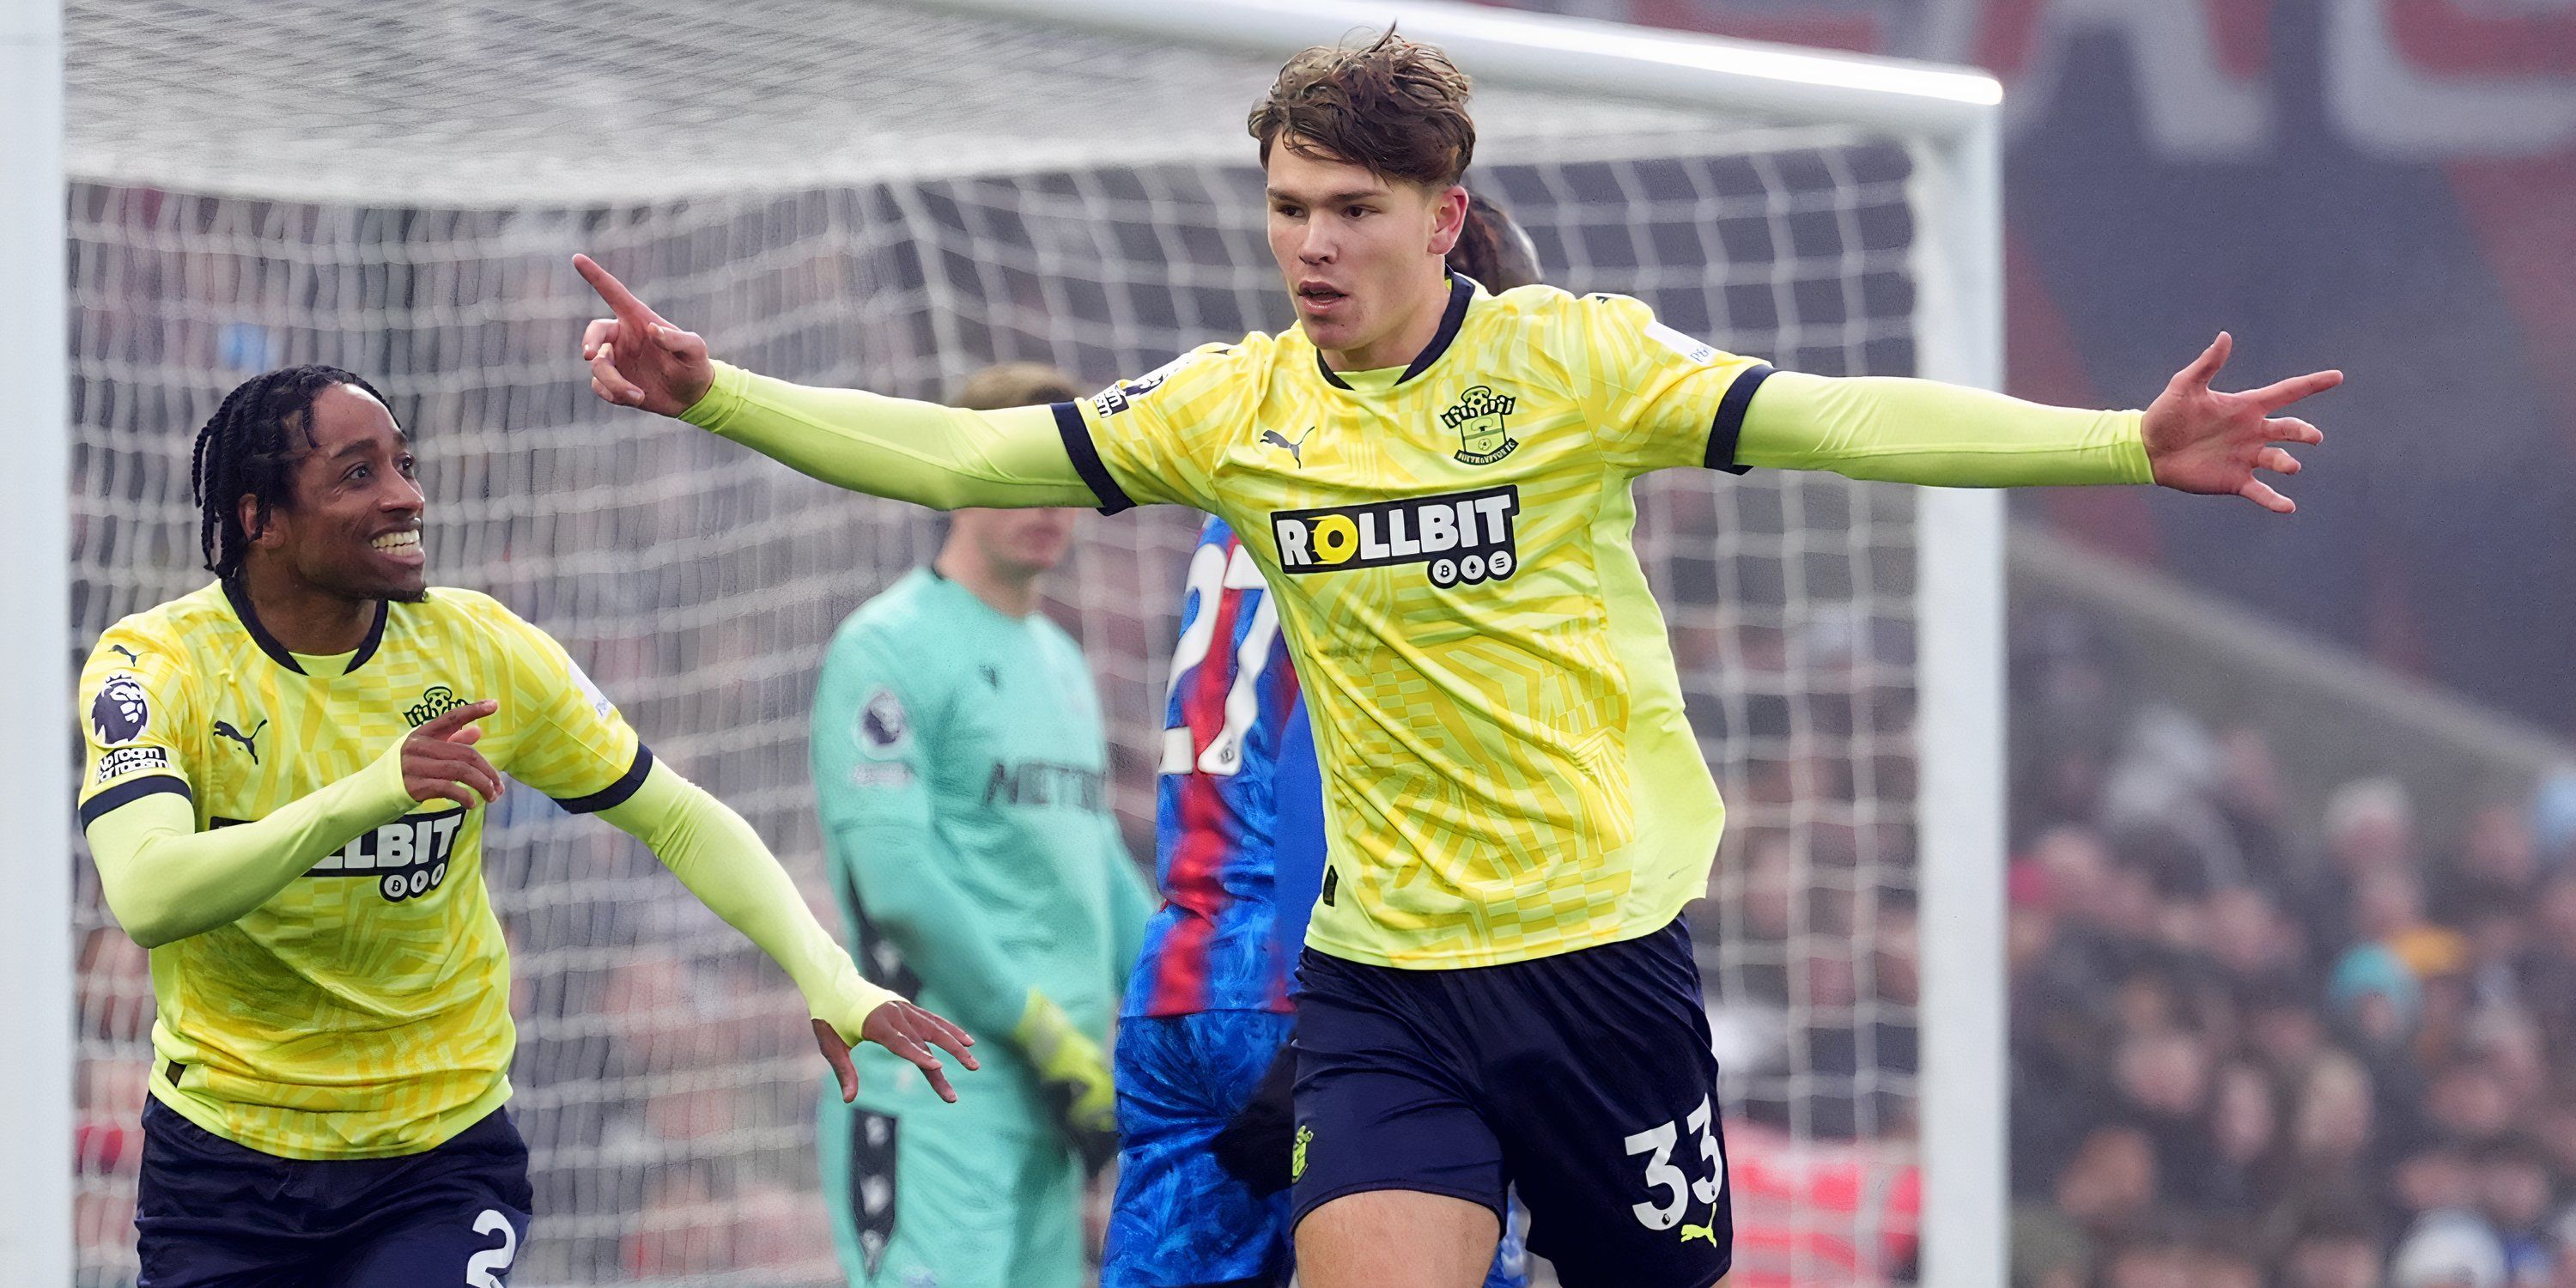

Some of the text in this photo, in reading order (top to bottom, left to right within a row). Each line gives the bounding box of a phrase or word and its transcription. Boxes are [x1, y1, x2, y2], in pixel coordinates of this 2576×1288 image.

[1276, 494, 1511, 566] ROLLBIT
[1158, 543, 1279, 775] 27
[113, 748, 160, 764] room
[1625, 1092, 1722, 1230] 33
[466, 1209, 517, 1288] 2
